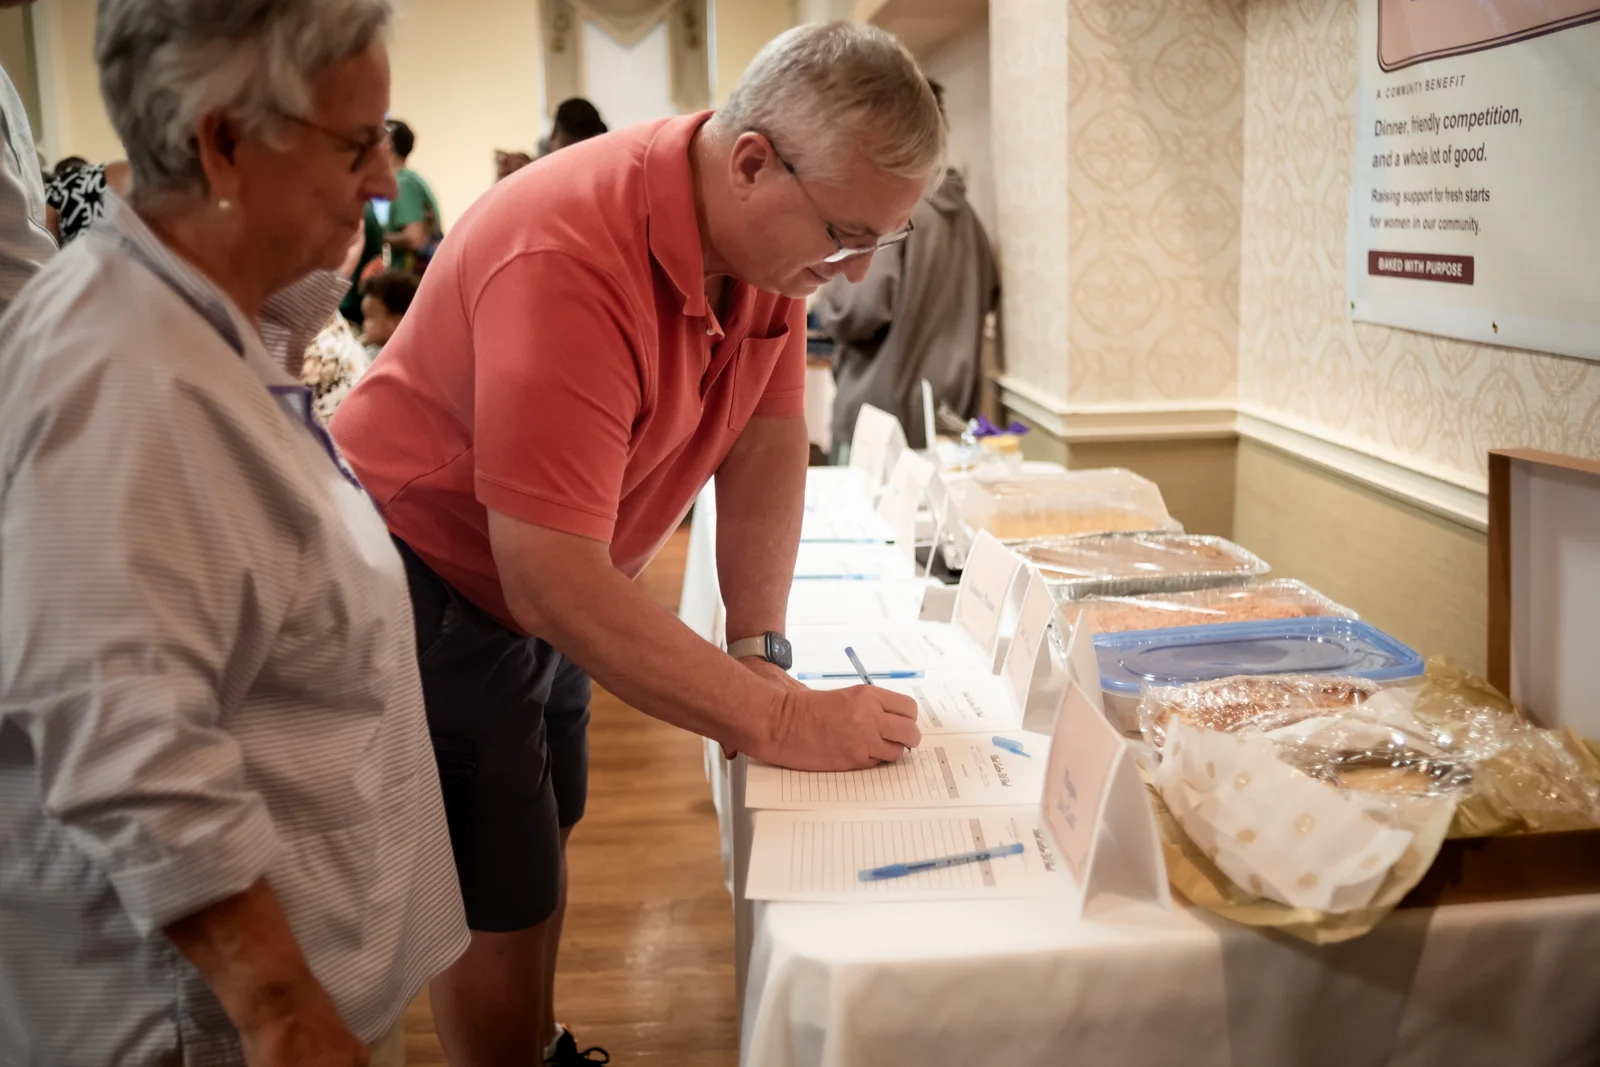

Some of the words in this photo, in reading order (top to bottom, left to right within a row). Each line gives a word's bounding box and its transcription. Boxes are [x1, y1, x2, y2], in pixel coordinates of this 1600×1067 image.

[1385, 81, 1422, 99] COMMUNITY
[1425, 75, 1466, 91] BENEFIT
[1374, 118, 1410, 137] Dinner,
[1411, 112, 1440, 136] friendly
[1443, 105, 1522, 132] competition,
[1372, 150, 1392, 168] and
[1394, 153, 1401, 168] a
[1403, 147, 1428, 167] whole
[1430, 145, 1441, 164] lot
[1443, 144, 1452, 164] of
[1454, 142, 1487, 168] good.
[1371, 188, 1401, 207] Raising
[1403, 189, 1432, 207] support
[1434, 187, 1445, 203] for
[1445, 187, 1463, 203] fresh
[1465, 187, 1490, 203] starts
[1370, 214, 1381, 229] for
[1384, 218, 1411, 230] women
[1413, 214, 1421, 230] in
[1422, 218, 1436, 230] our
[1438, 215, 1482, 236] community.
[1378, 256, 1403, 272] BAKED
[1404, 258, 1425, 273] WITH
[1425, 260, 1463, 277] PURPOSE
